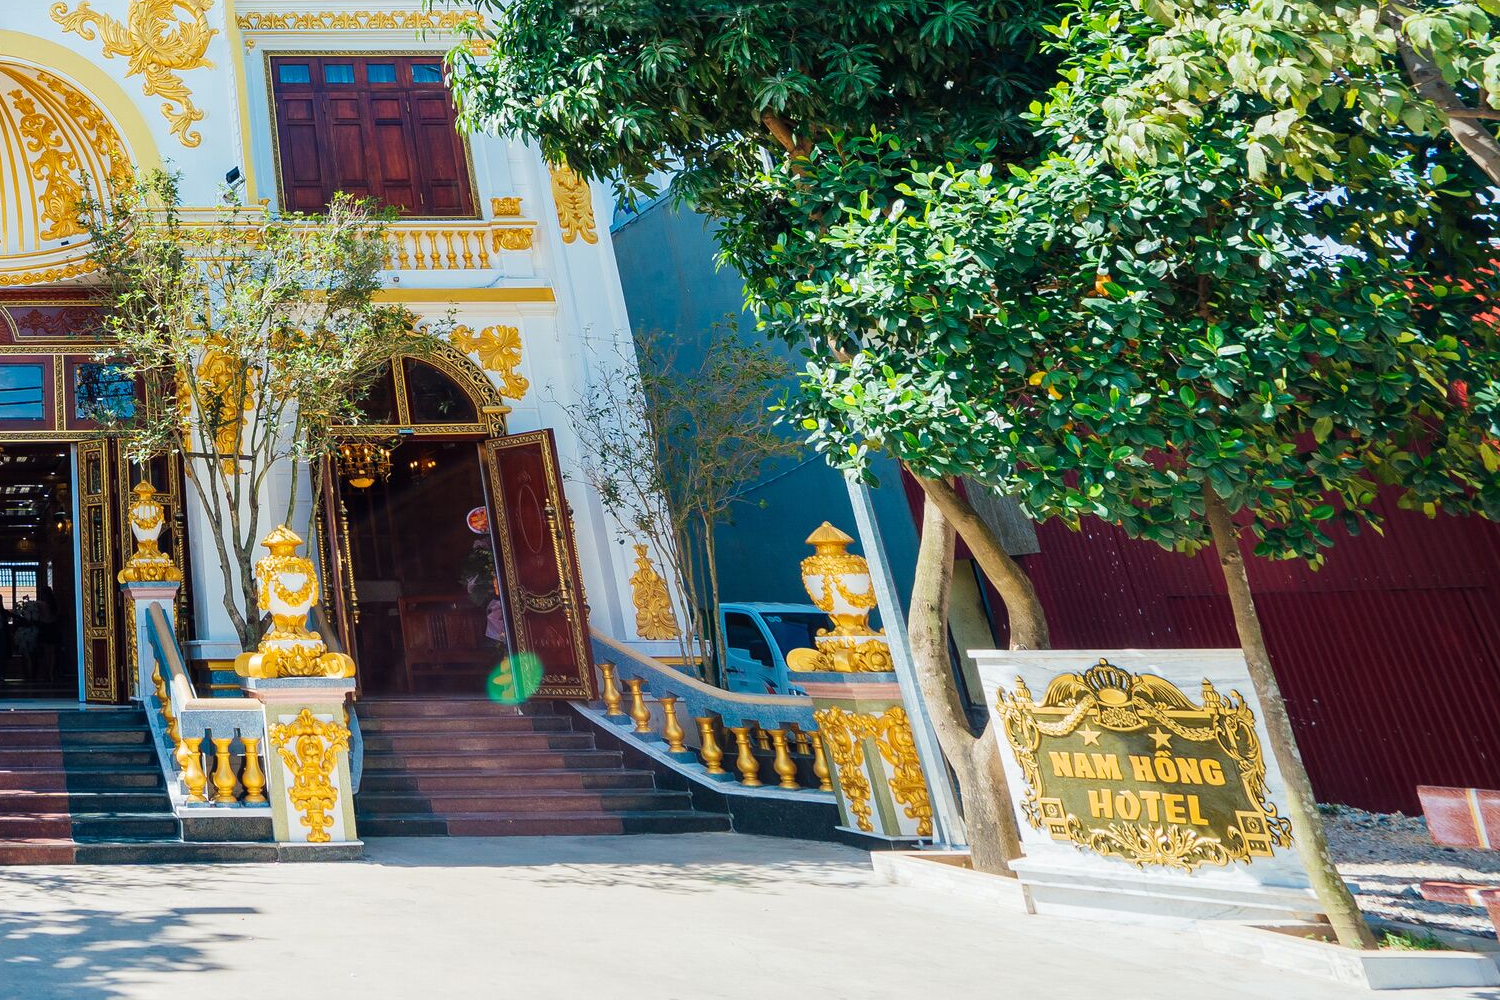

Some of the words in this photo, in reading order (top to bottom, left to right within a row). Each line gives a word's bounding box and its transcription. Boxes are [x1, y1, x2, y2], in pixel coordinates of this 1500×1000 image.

[1048, 751, 1123, 780] NAM
[1128, 750, 1226, 786] HỒNG
[1088, 789, 1209, 825] HOTEL
